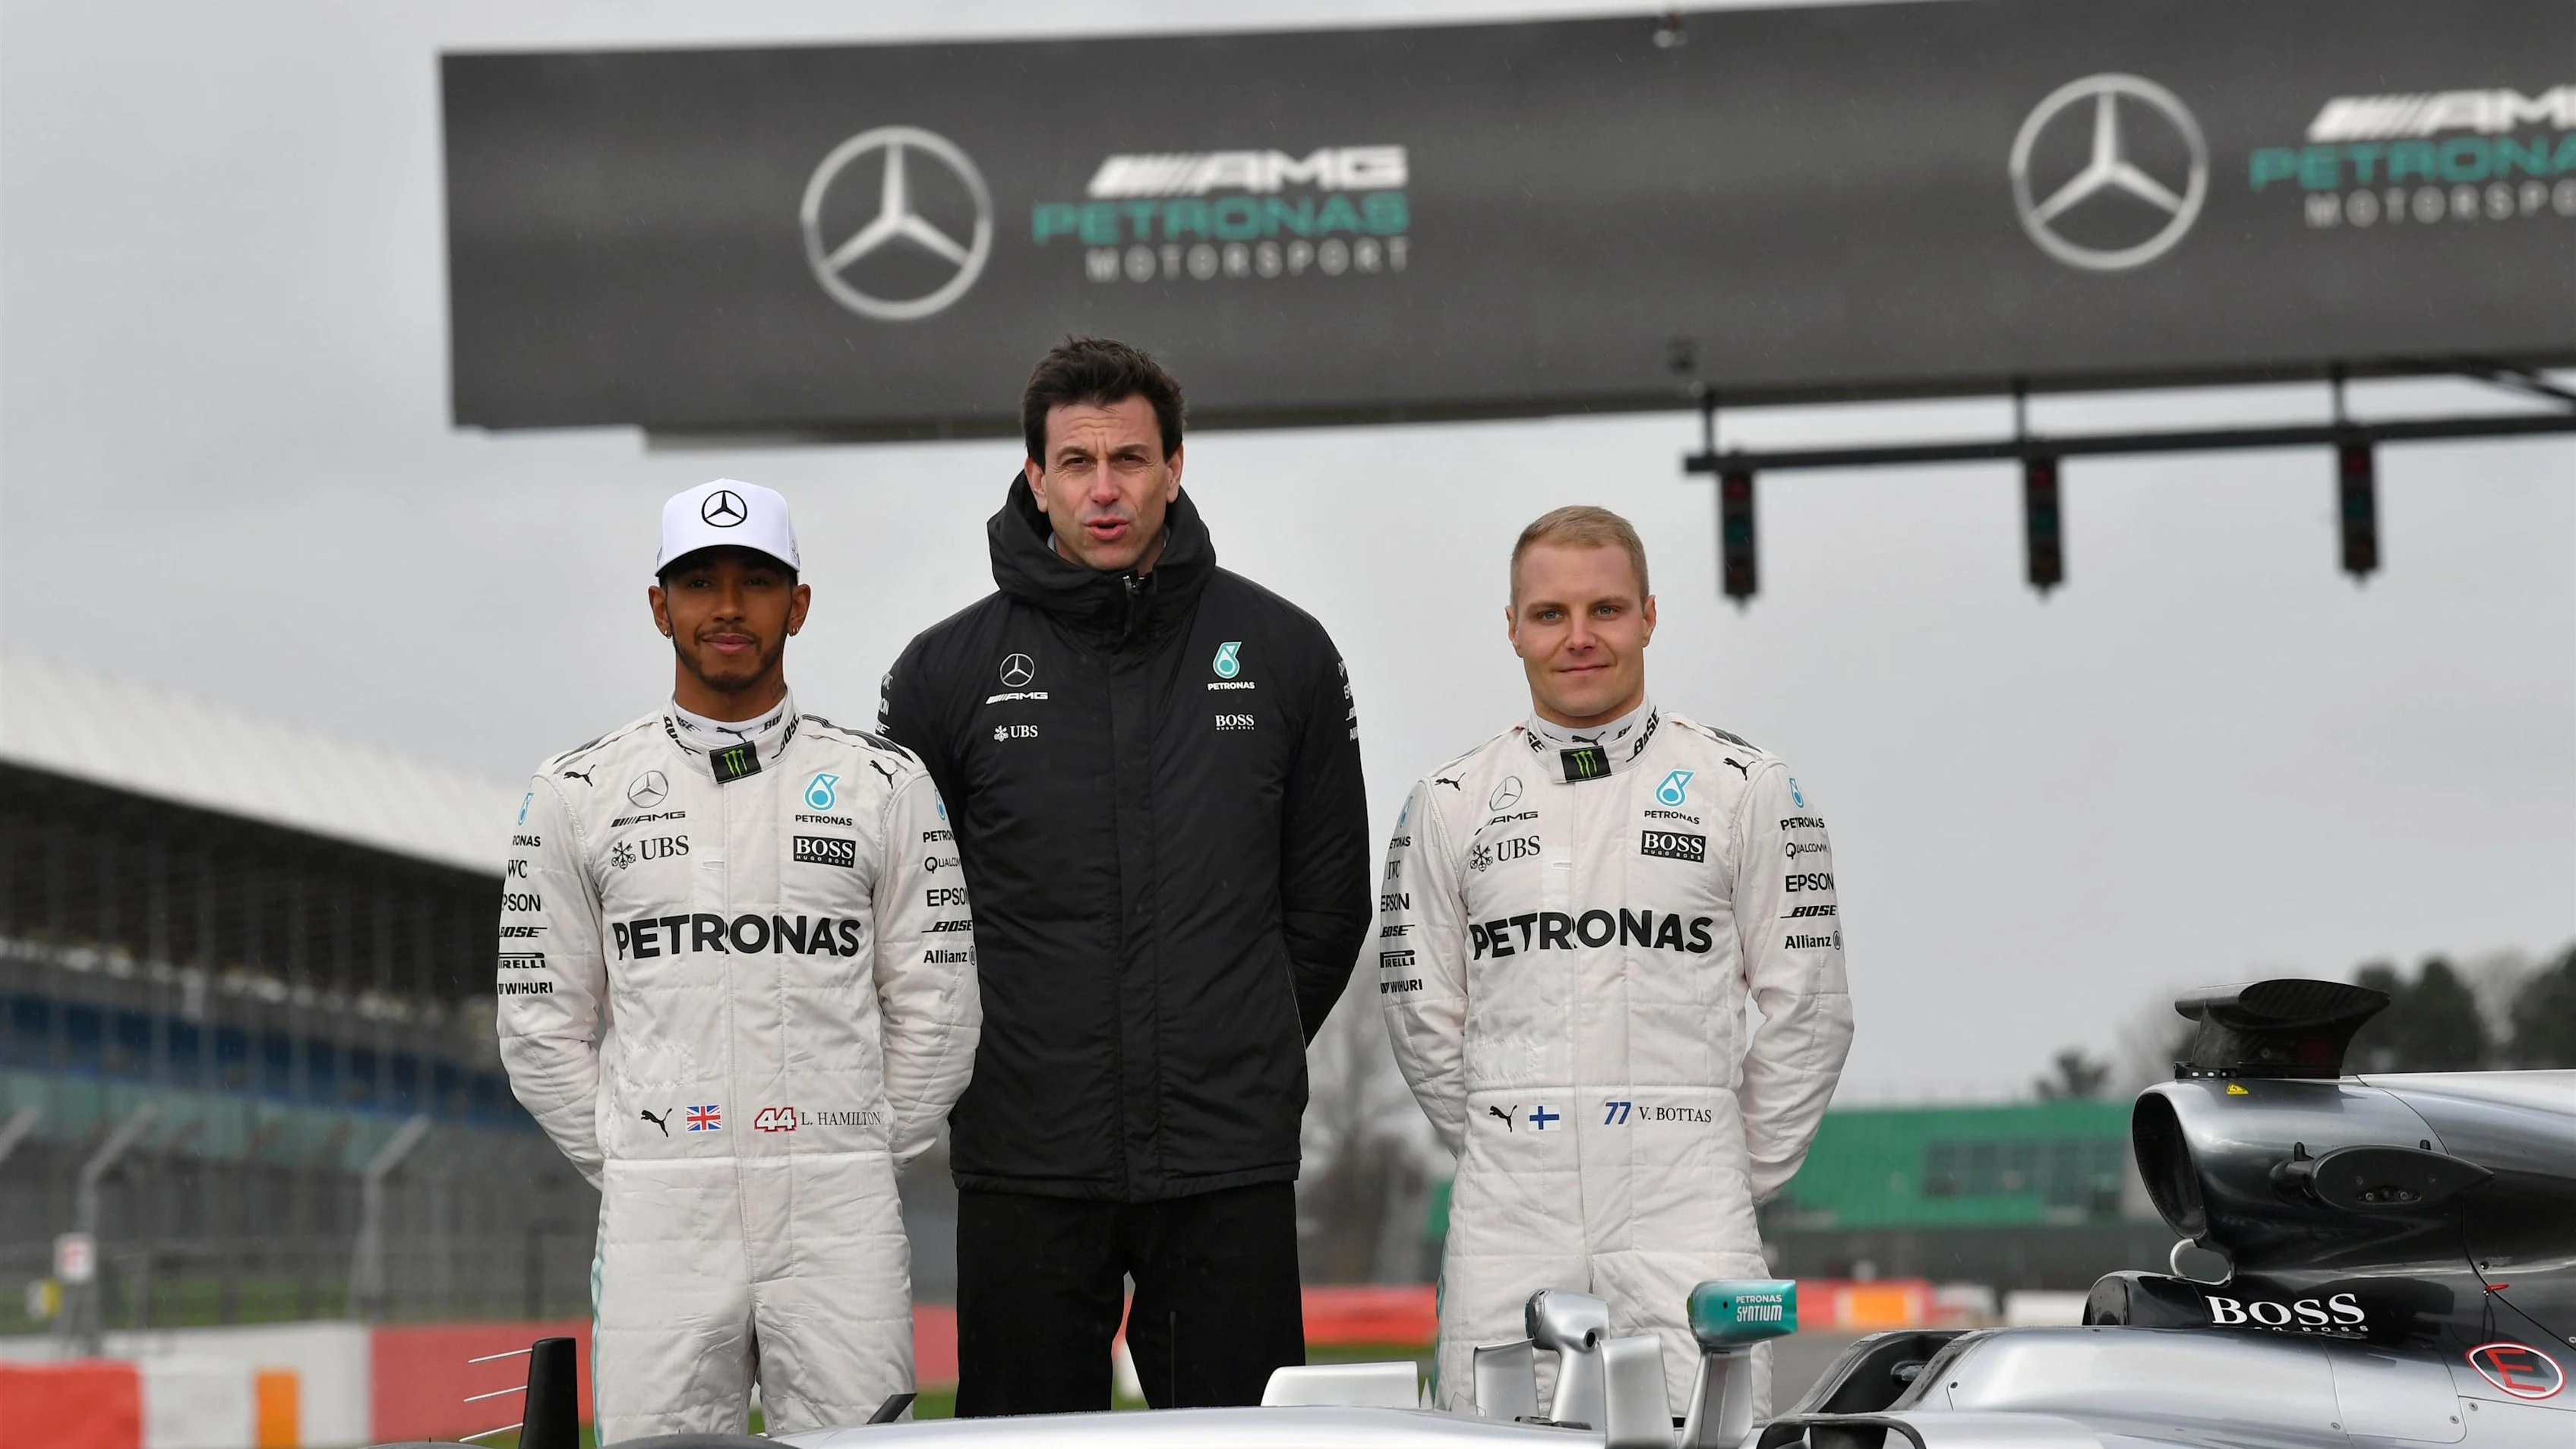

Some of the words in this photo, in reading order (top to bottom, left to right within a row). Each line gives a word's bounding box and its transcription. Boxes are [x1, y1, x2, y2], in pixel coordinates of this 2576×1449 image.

[2427, 84, 2576, 134] AM
[1196, 144, 1410, 194] AMG
[2248, 132, 2576, 193] PETRONA
[2303, 177, 2576, 228] MOTORSPO
[1031, 188, 1411, 246] PETRONAS
[1084, 235, 1409, 283] MOTORSPORT
[1207, 681, 1255, 691] PETRONAS
[1004, 691, 1049, 702] AMG
[1214, 713, 1255, 727] BOSS
[1009, 724, 1038, 738] UBS
[632, 810, 687, 824] AMG
[795, 814, 853, 826] PETRONAS
[1488, 810, 1539, 826] AMG
[1644, 810, 1700, 825] PETRONAS
[1780, 816, 1825, 831] PETRONAS
[512, 835, 541, 847] RONAS
[639, 835, 690, 860] UBS
[796, 838, 854, 860] BOSS
[1496, 835, 1541, 862] UBS
[1643, 832, 1703, 854] BOSS
[507, 859, 528, 879] WC
[1785, 873, 1834, 892] EPSON
[501, 893, 541, 912] PSON
[1381, 892, 1410, 913] EPSON
[1780, 904, 1836, 919] BOSE
[921, 920, 972, 933] BOSE
[1469, 908, 1713, 961] PETRONAS
[611, 914, 861, 961] PETRONAS
[1785, 936, 1832, 949] Allianz
[923, 949, 968, 964] Allianz
[1380, 949, 1416, 968] PIRELLI
[505, 982, 554, 995] WIHURI
[754, 1106, 797, 1132] 44
[800, 1113, 813, 1125] L.
[818, 1111, 882, 1126] HAMILTON
[1604, 1102, 1632, 1125] 77
[1638, 1106, 1651, 1121] V.
[1656, 1107, 1713, 1123] BOTTAS
[1735, 1294, 1783, 1304] PETRONAS
[2204, 1293, 2366, 1326] BOSS
